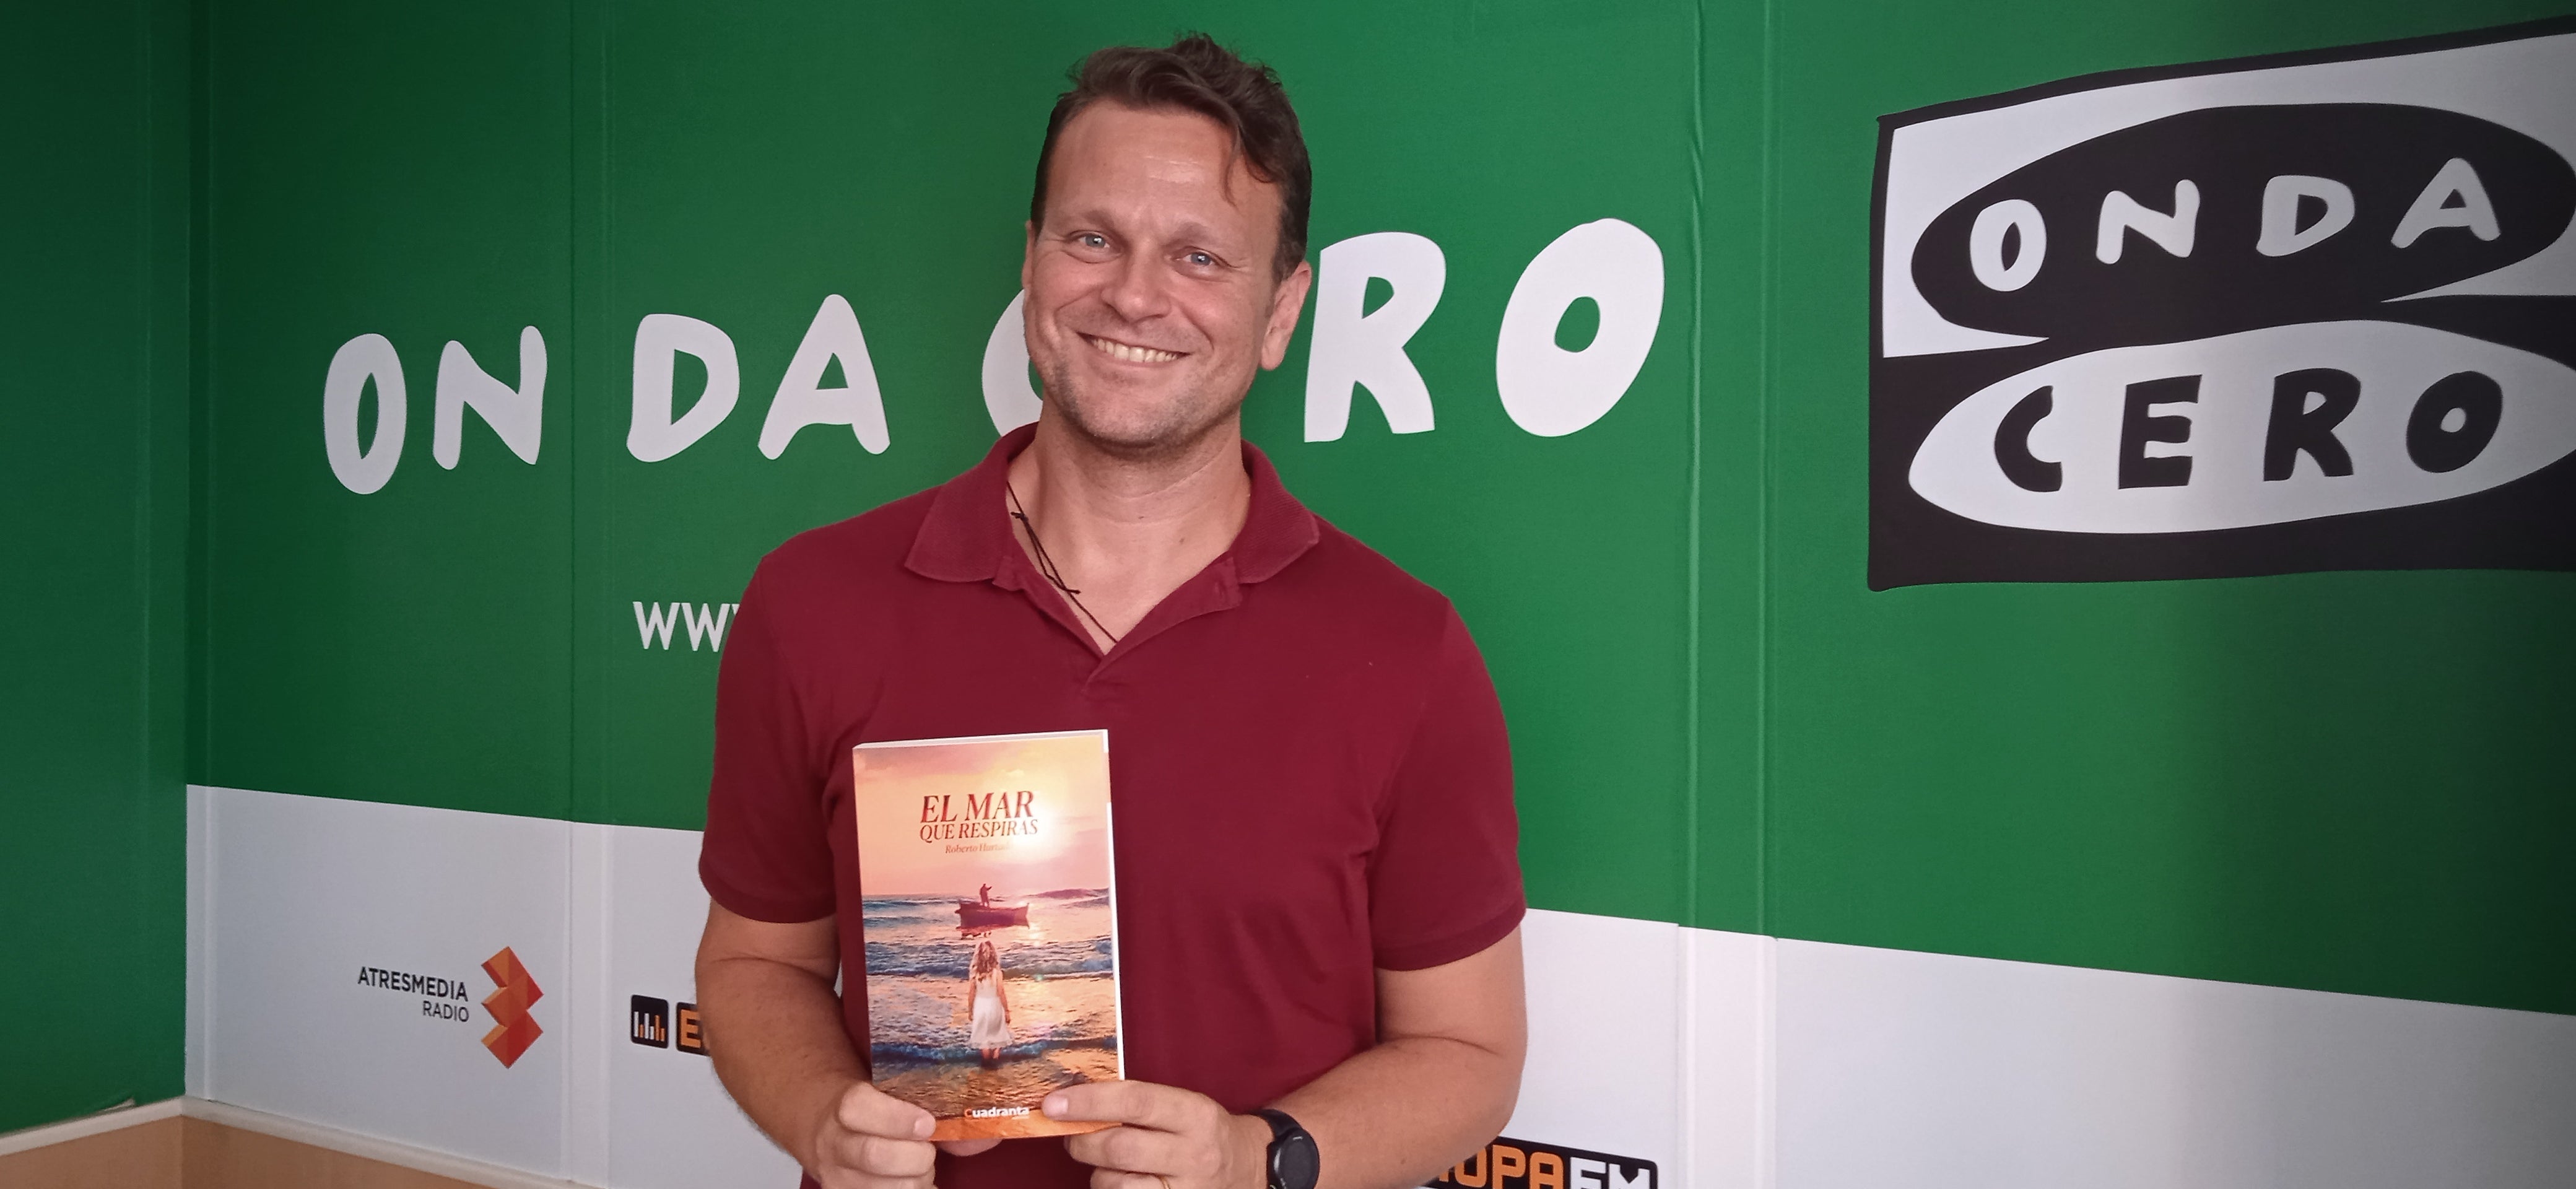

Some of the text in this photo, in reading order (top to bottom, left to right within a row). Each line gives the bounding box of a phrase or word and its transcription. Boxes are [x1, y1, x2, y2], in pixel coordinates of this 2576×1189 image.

[1970, 157, 2502, 292] ONDA
[323, 294, 891, 494] ONDA
[1994, 368, 2504, 493] CERO
[633, 601, 741, 652] WW
[920, 791, 1034, 824] EL MAR
[920, 819, 1038, 843] QUE RESPIRAS
[945, 843, 978, 854] Roberto
[357, 966, 469, 1002] ATRESMEDIA
[423, 1000, 469, 1022] RADIO
[964, 1106, 1030, 1118] Cuadranta
